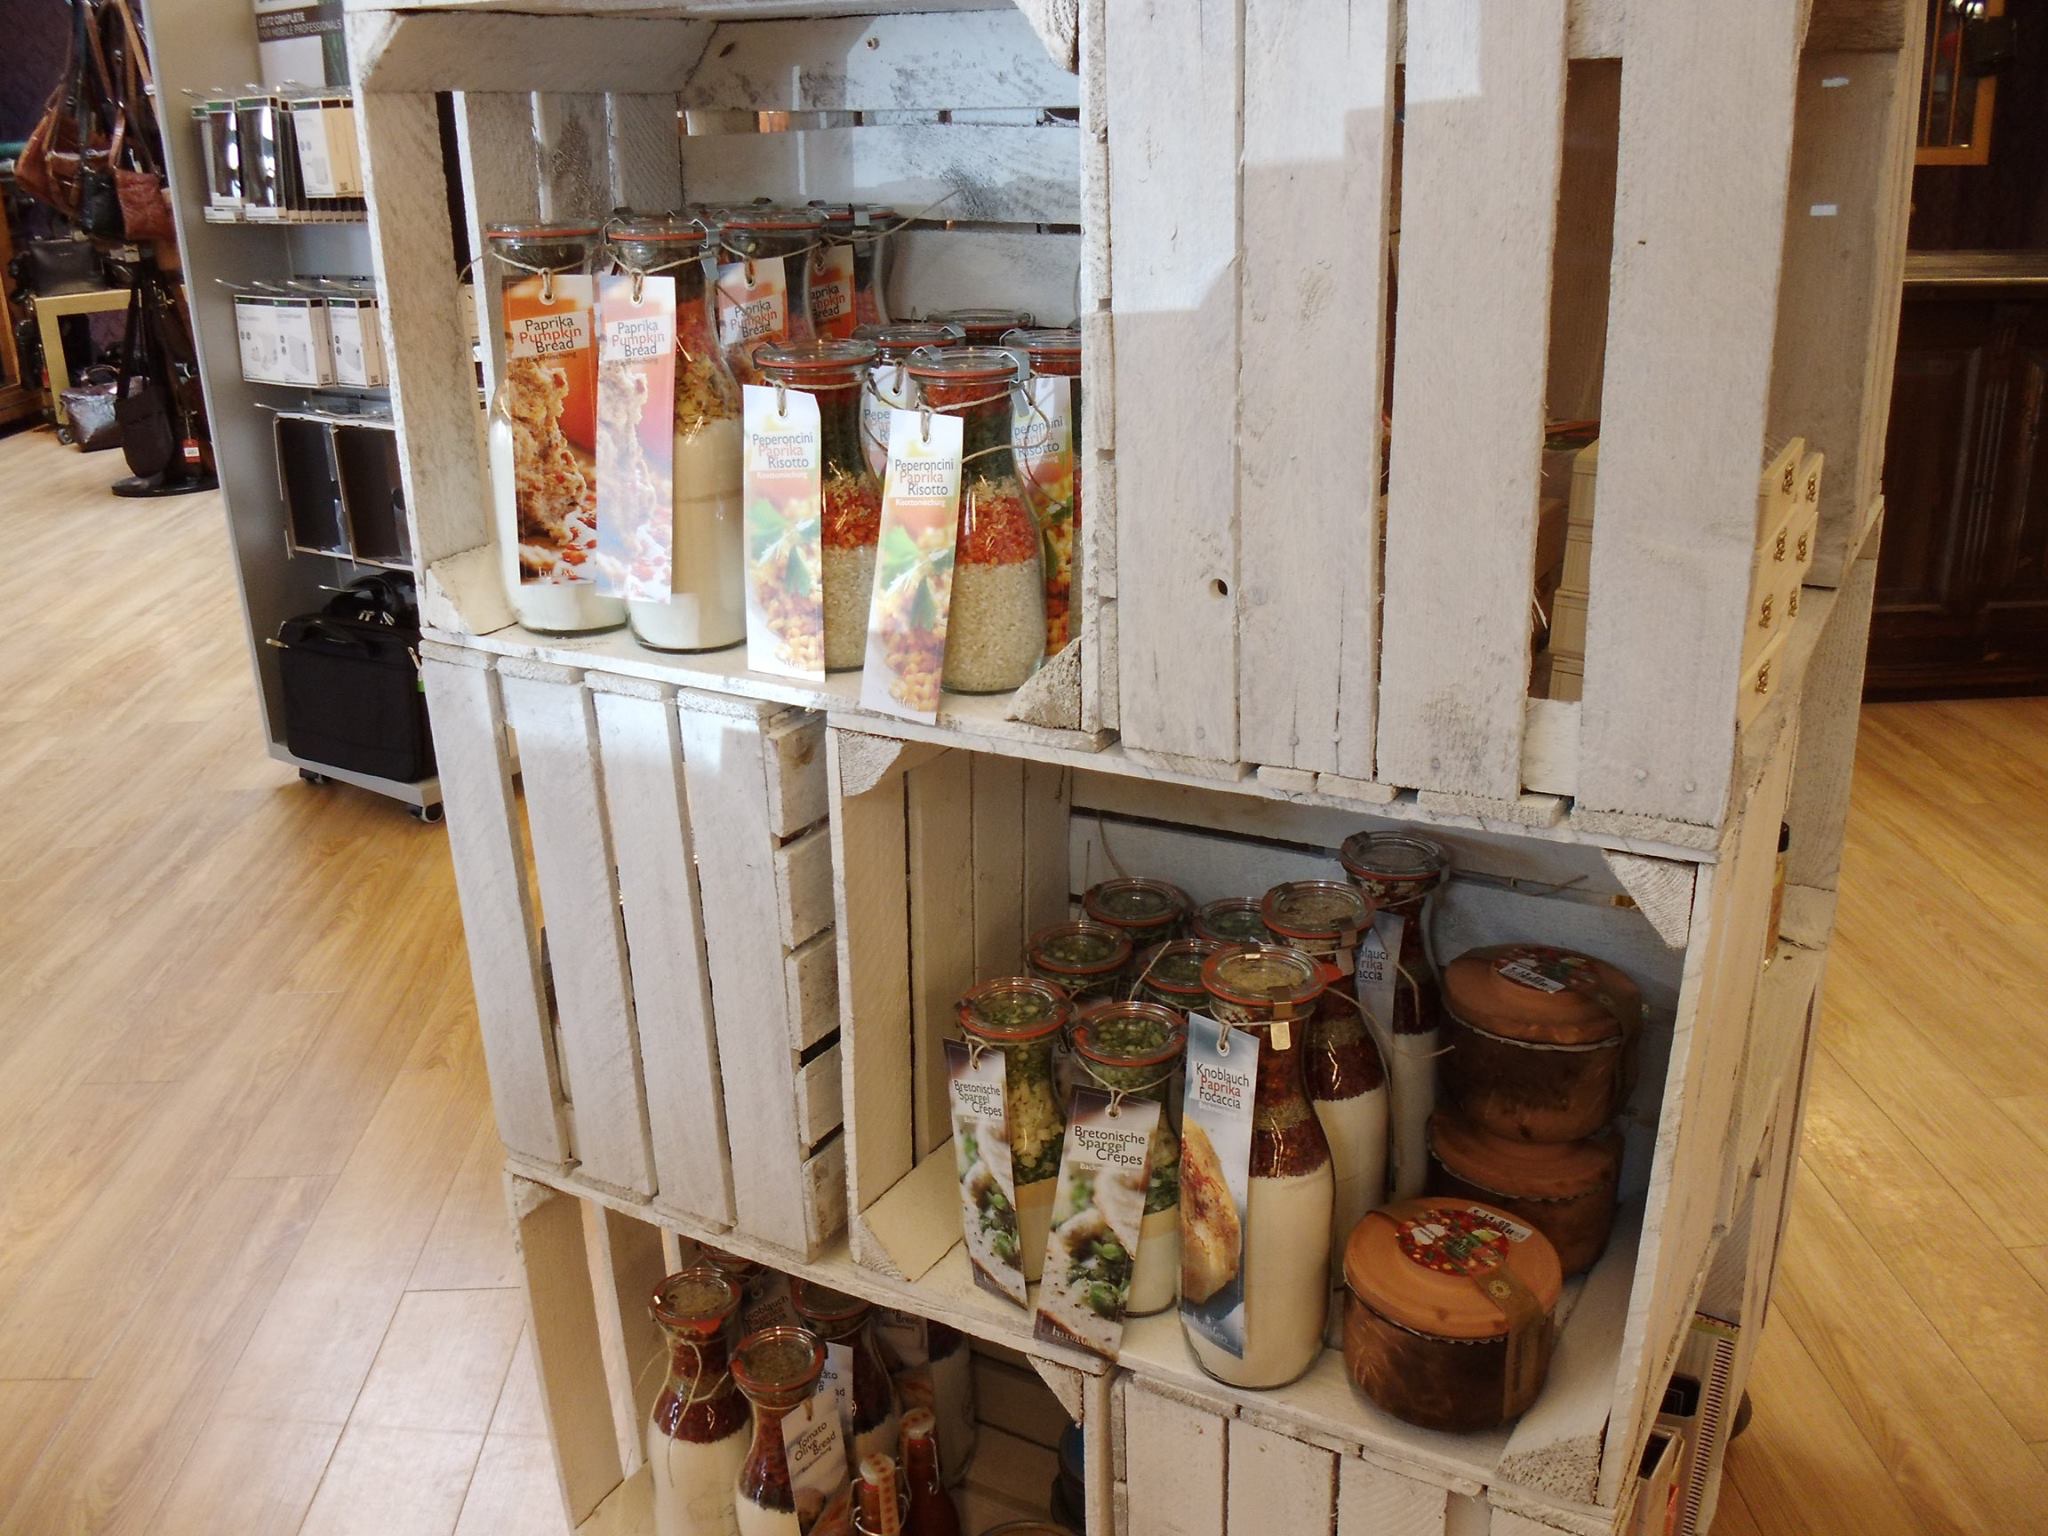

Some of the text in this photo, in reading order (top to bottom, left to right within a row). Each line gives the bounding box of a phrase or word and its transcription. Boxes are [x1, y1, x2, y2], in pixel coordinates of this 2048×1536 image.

[525, 316, 574, 333] Paprika
[617, 320, 658, 336] Paprika
[519, 328, 582, 344] Pumpkin
[611, 333, 665, 347] Pumpkin
[535, 338, 574, 353] Bread
[624, 343, 657, 357] Bread
[752, 432, 814, 446] Peperoncini
[759, 444, 803, 458] Paprika
[768, 456, 809, 469] Risotto
[895, 458, 954, 473] Peperoncini
[900, 469, 944, 484] Paprika
[908, 482, 948, 496] Risotto
[1196, 1063, 1250, 1087] Knoblauch
[954, 1080, 1001, 1096] Bretonische
[1200, 1075, 1241, 1097] Paprika
[960, 1091, 990, 1103] Spargel
[1199, 1087, 1241, 1109] Focaccia
[1074, 1125, 1145, 1144] Bretonische
[1078, 1137, 1126, 1153] Spargel
[799, 1422, 827, 1449] Tomato
[813, 1431, 836, 1455] Bread
[795, 1439, 817, 1461] Olive
